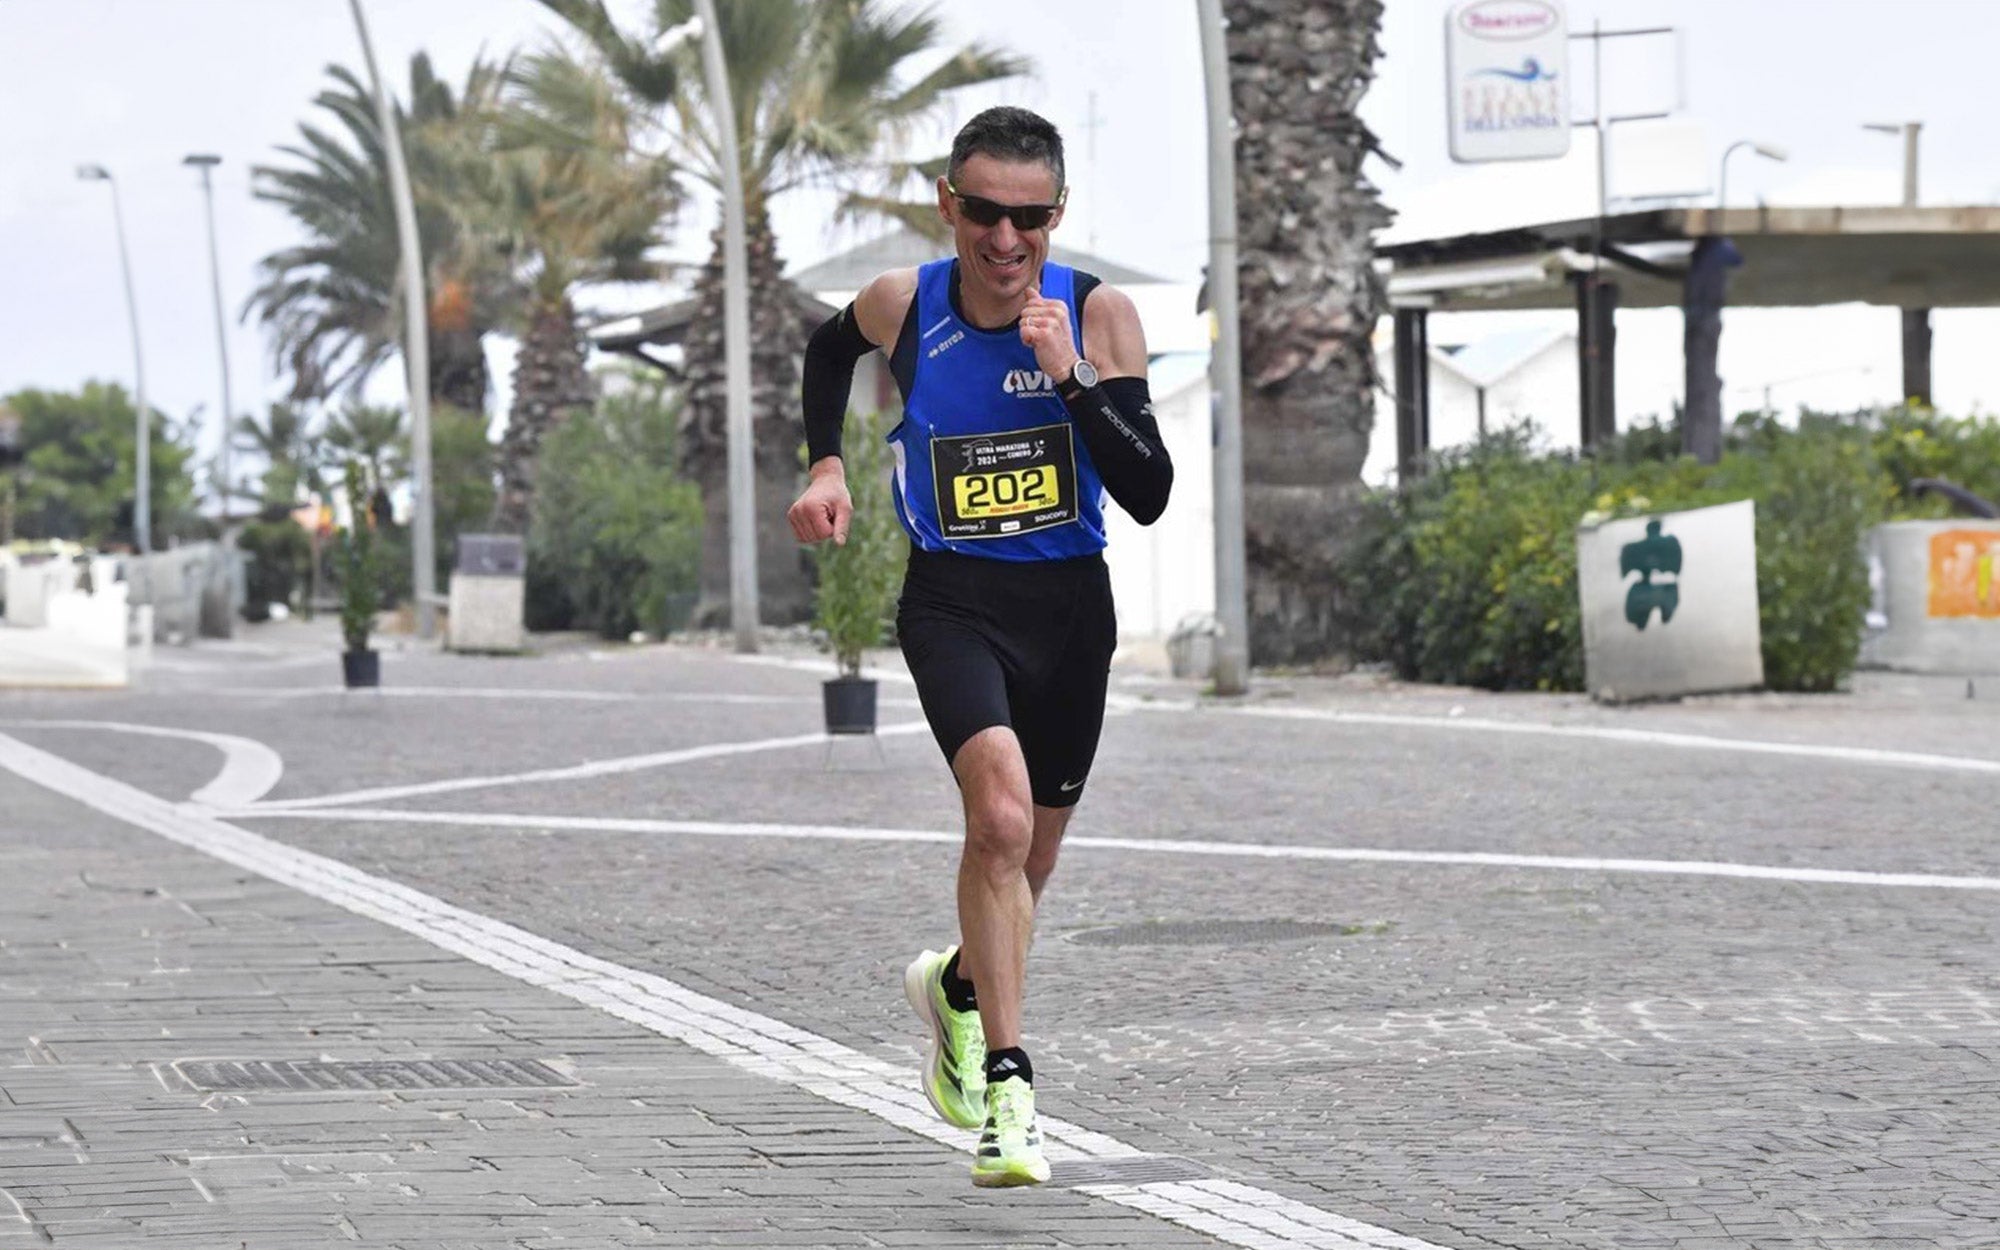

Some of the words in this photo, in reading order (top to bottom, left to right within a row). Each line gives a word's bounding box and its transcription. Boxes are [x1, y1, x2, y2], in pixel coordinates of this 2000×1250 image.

[1003, 370, 1056, 393] AVI
[1101, 406, 1152, 460] BOOSTER
[975, 446, 994, 454] ULTRA
[977, 456, 997, 465] 2024
[965, 469, 1046, 508] 202
